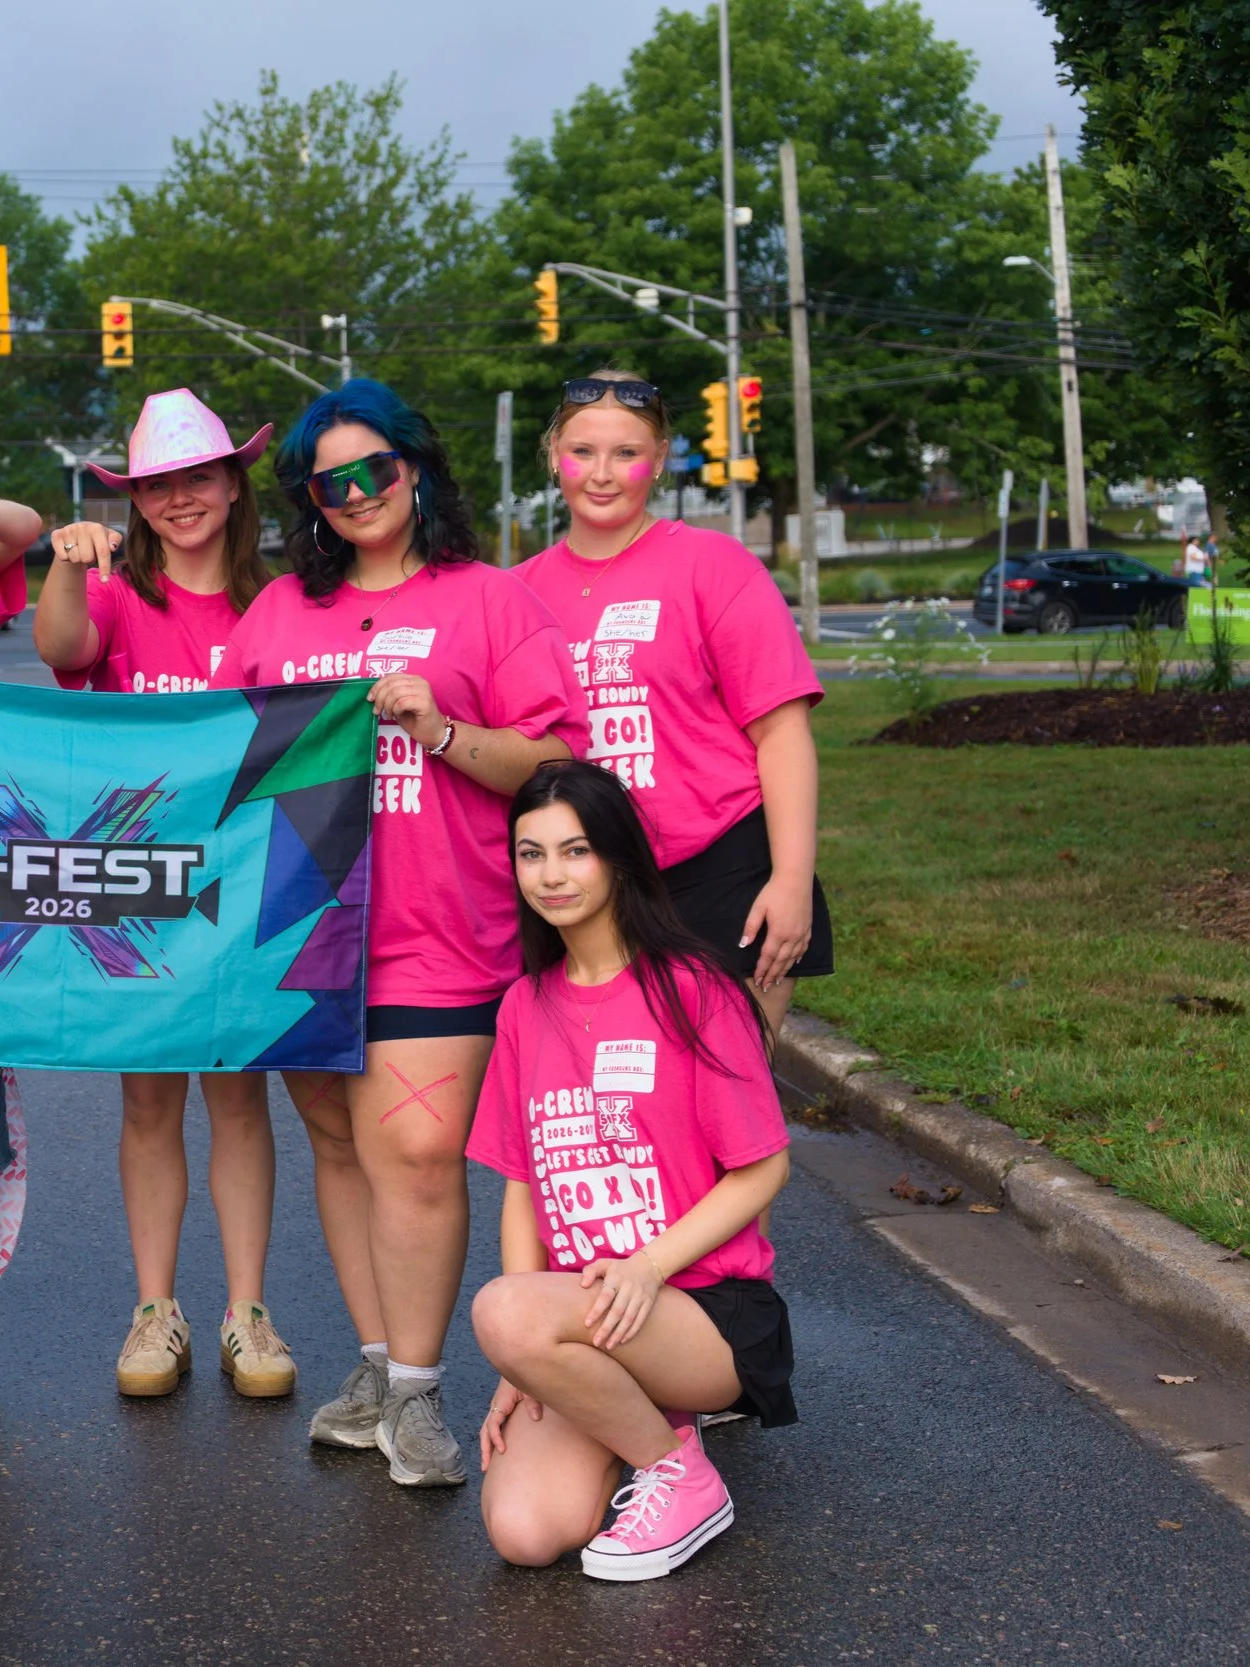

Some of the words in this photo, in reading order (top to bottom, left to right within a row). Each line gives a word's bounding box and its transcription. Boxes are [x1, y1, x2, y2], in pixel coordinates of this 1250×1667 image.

[282, 651, 364, 683] O-CREW
[597, 657, 626, 669] StFX
[133, 671, 209, 693] O-CREW
[599, 686, 649, 705] ROWDY
[604, 714, 647, 746] GO!
[376, 735, 417, 766] GO!
[25, 897, 92, 918] 2026
[616, 1043, 633, 1051] NAME
[546, 1149, 586, 1170] LET'S
[588, 1146, 610, 1165] GET
[613, 1143, 653, 1164] RWDY
[558, 1181, 594, 1213] GO
[604, 1175, 623, 1205] X
[572, 1211, 666, 1260] O-WE
